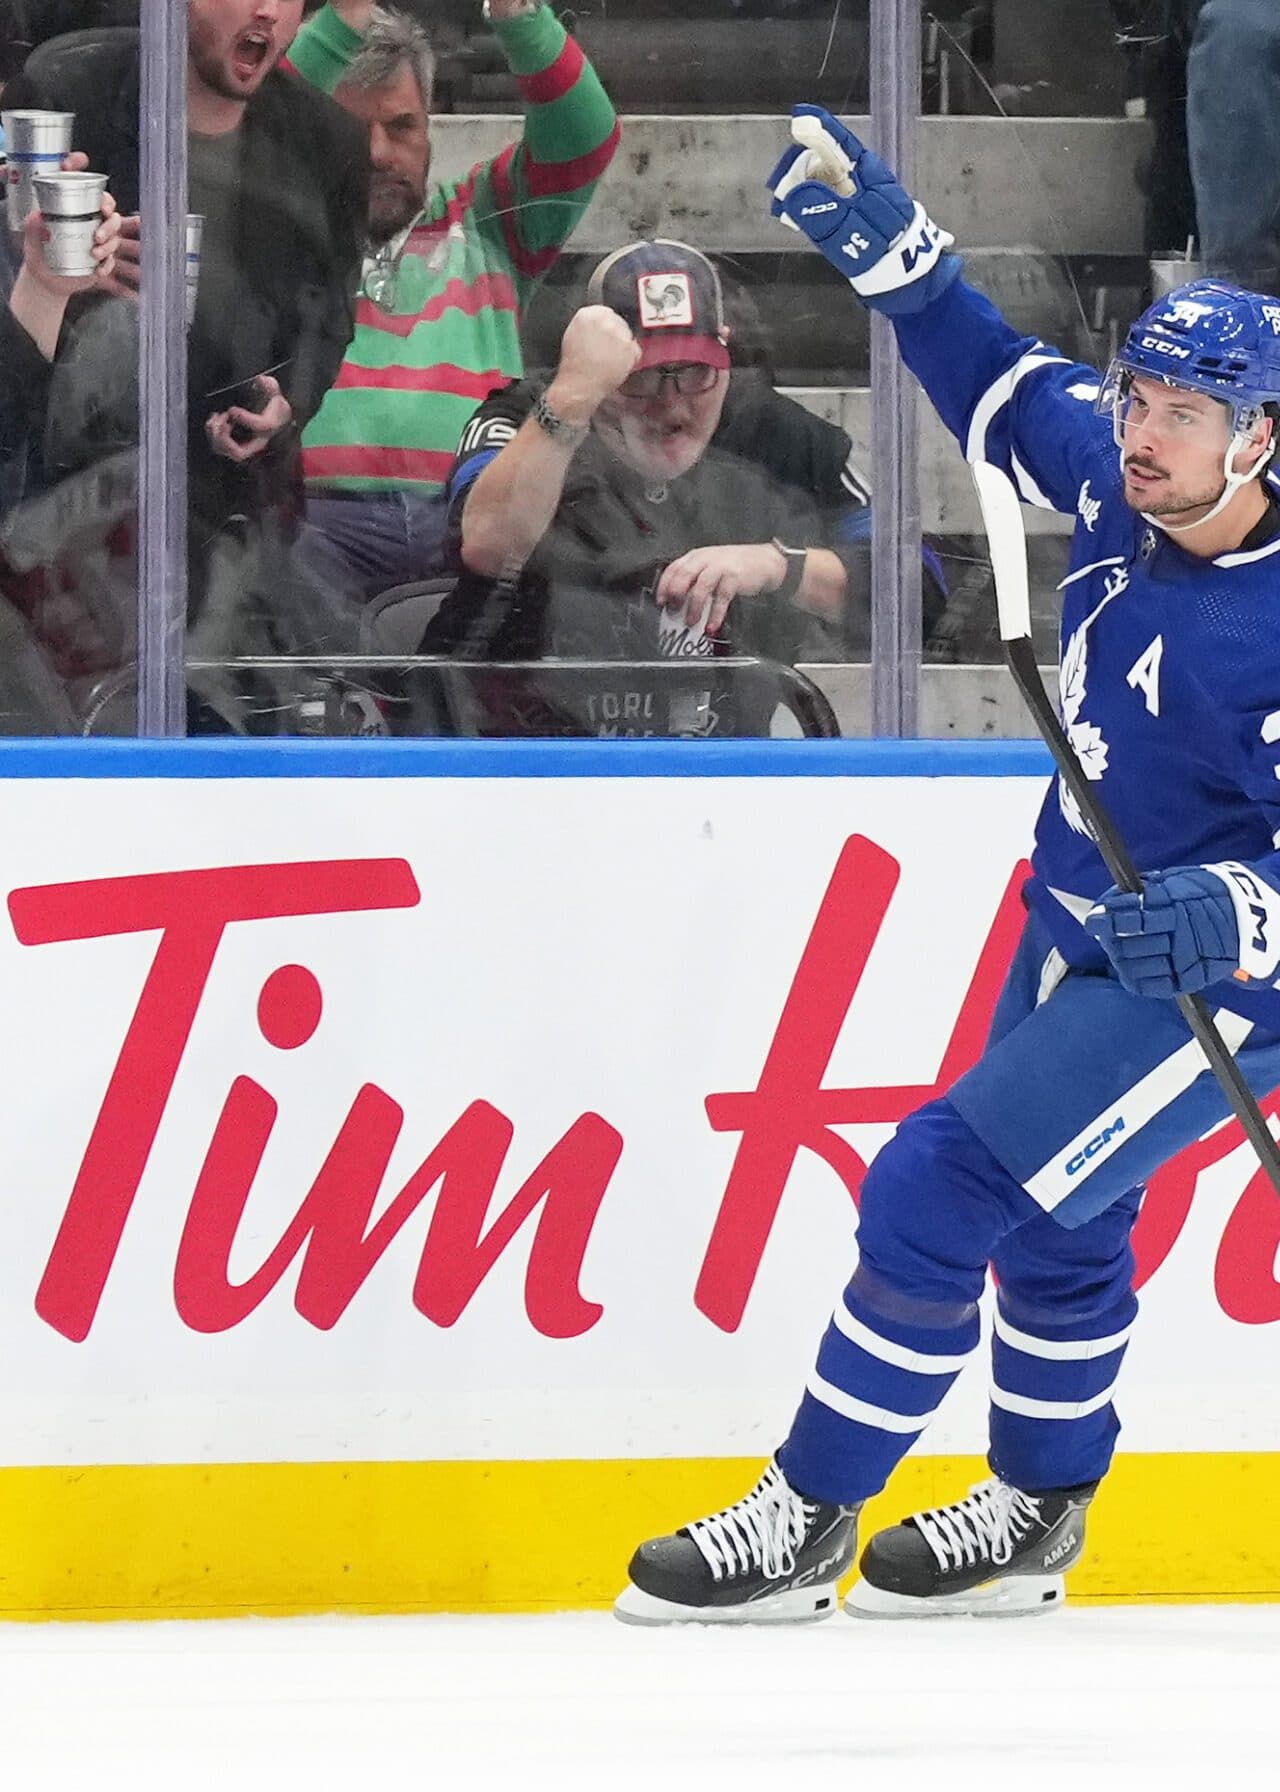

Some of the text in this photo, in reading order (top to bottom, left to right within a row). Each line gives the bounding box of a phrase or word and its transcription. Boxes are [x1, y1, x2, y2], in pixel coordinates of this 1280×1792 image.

[1141, 336, 1191, 360] CCM
[1126, 633, 1163, 718] A
[1223, 863, 1268, 954] CM
[6, 857, 624, 1343] Tim
[1065, 1116, 1125, 1176] CCM
